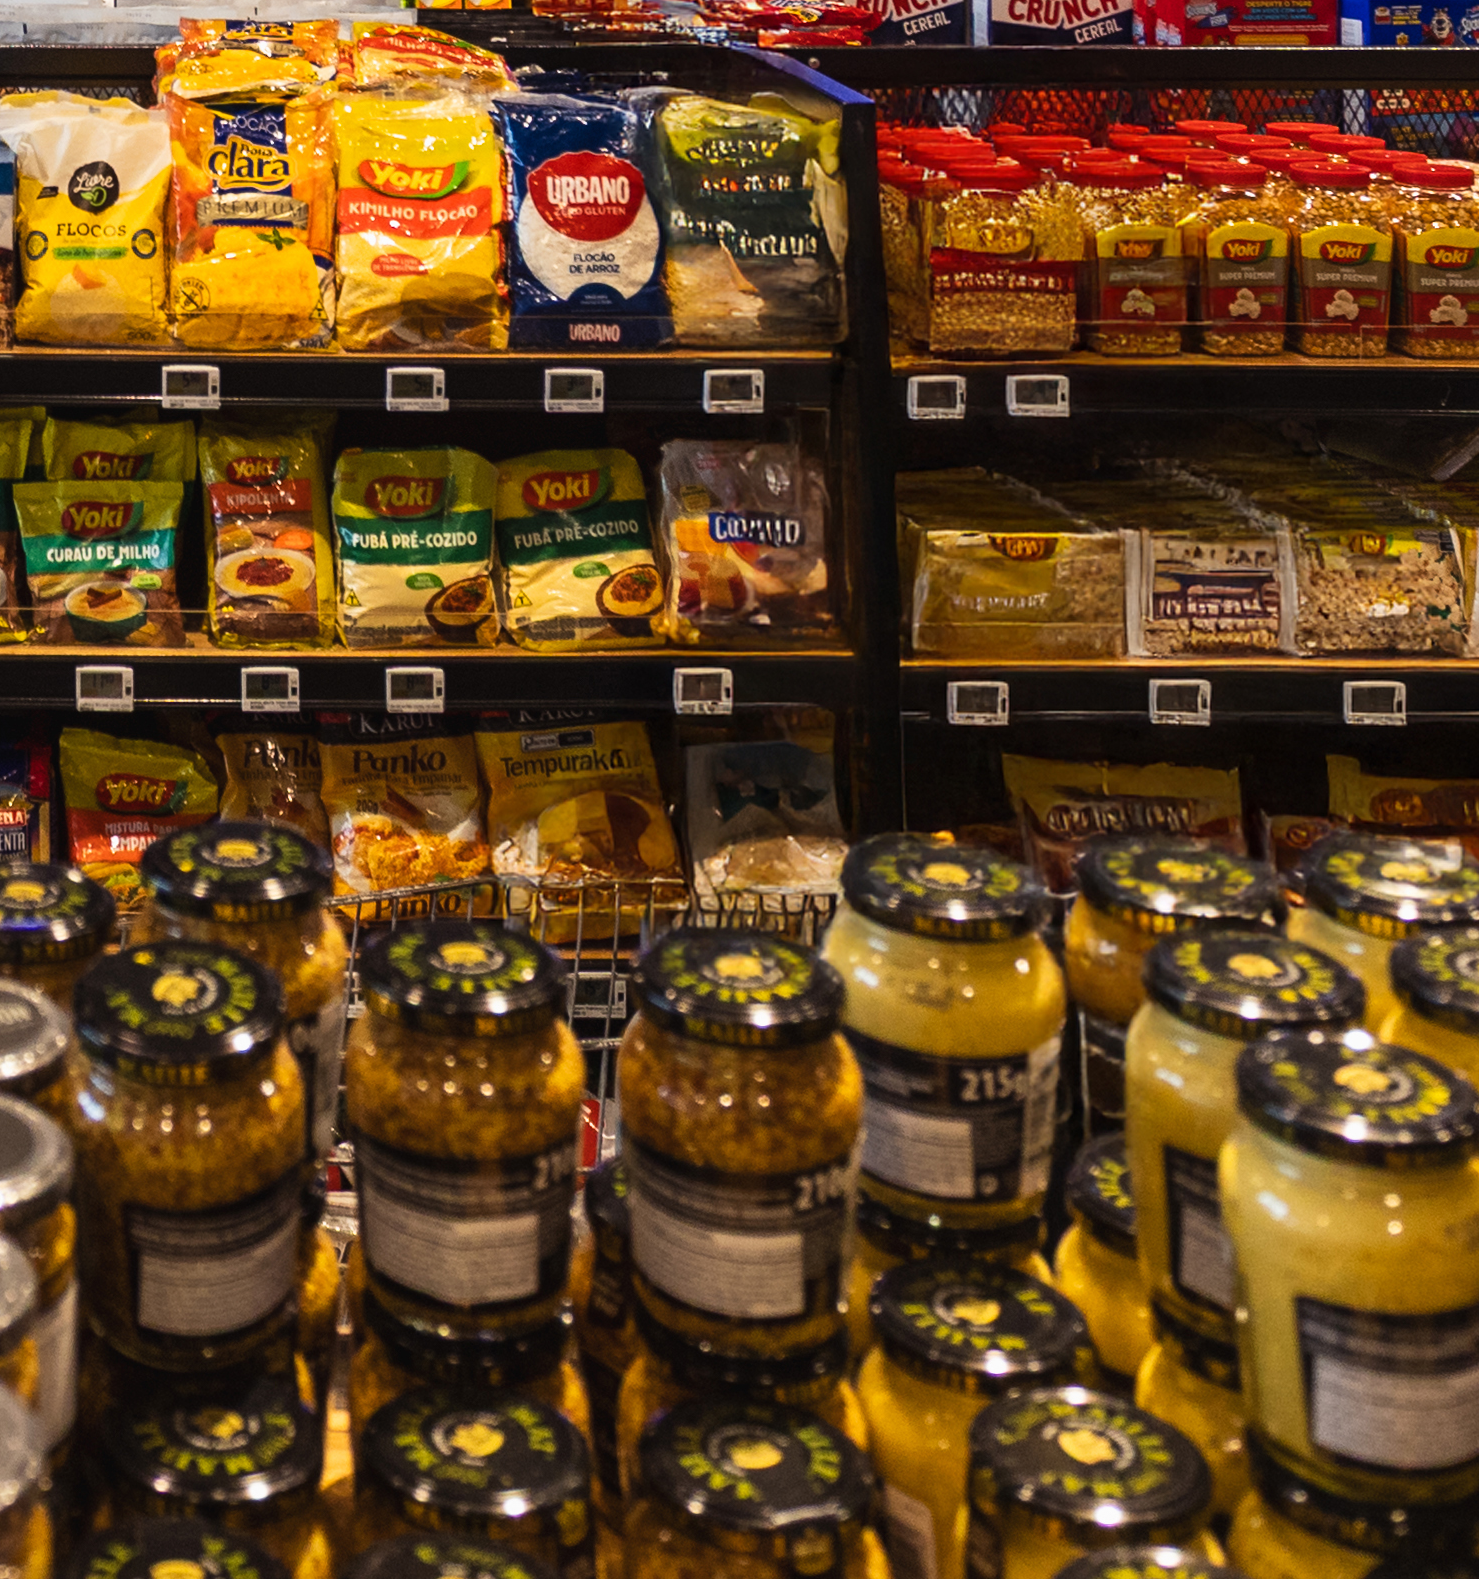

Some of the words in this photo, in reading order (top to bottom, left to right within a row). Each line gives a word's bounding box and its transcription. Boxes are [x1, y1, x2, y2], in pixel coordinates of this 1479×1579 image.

[904, 11, 951, 36] CEREAL
[1073, 21, 1122, 43] CEREAL
[369, 161, 443, 190] Yoki
[546, 175, 630, 205] URBANO
[349, 202, 415, 221] KIMILHO
[420, 206, 478, 223] FLOCÃO
[56, 222, 126, 238] FLOCOS
[574, 252, 615, 263] FLOCÃO
[570, 265, 583, 273] DE
[586, 265, 620, 273] ARROZ
[569, 324, 620, 342] URBANO
[68, 505, 124, 529] Yoki
[351, 529, 388, 549] FUBÁ
[390, 529, 477, 550] PRÉ-COZIDO
[46, 546, 88, 562] CURAU
[91, 545, 115, 561] DE
[118, 544, 161, 560] MILHO
[353, 745, 447, 773] Panko
